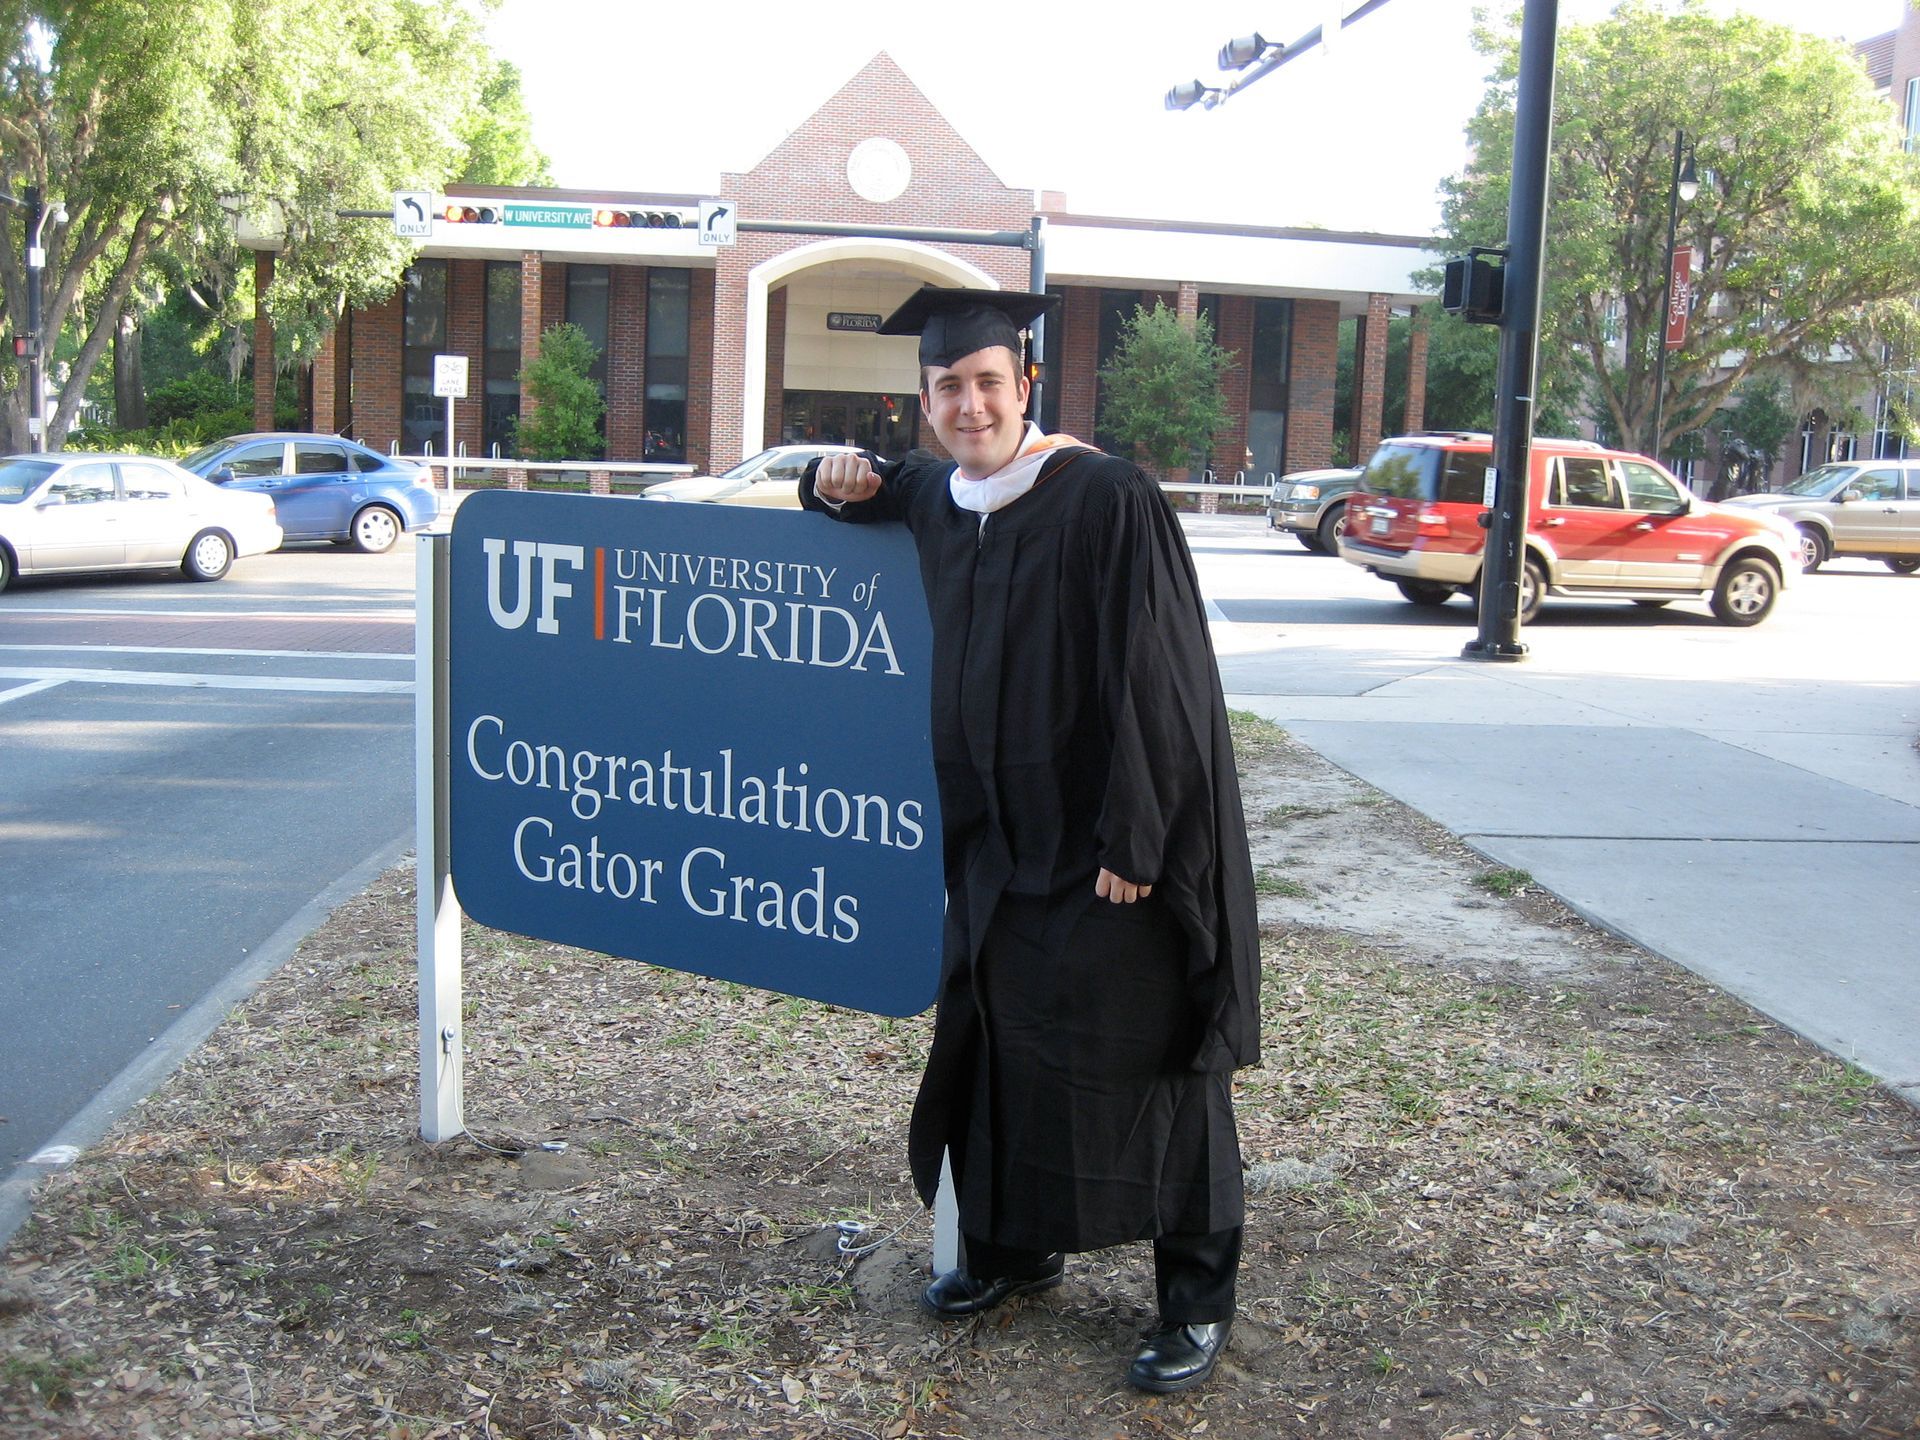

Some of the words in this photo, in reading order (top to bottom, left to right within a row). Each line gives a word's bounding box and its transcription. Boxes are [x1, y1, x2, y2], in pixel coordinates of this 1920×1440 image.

[400, 224, 427, 234] ONLY
[505, 209, 514, 222] W
[514, 210, 573, 224] UNIVERSITY
[572, 212, 592, 225] AVE
[703, 233, 730, 243] ONLY
[842, 319, 877, 328] FLORIDA
[1670, 271, 1681, 326] College
[1676, 282, 1687, 315] Park
[483, 538, 584, 635] UF
[614, 548, 838, 600] UNIVERSITY
[852, 572, 881, 611] of
[613, 585, 906, 677] FLORIDA
[466, 714, 925, 852] Congratulations
[513, 816, 664, 905] Gator
[680, 847, 861, 945] Grads
